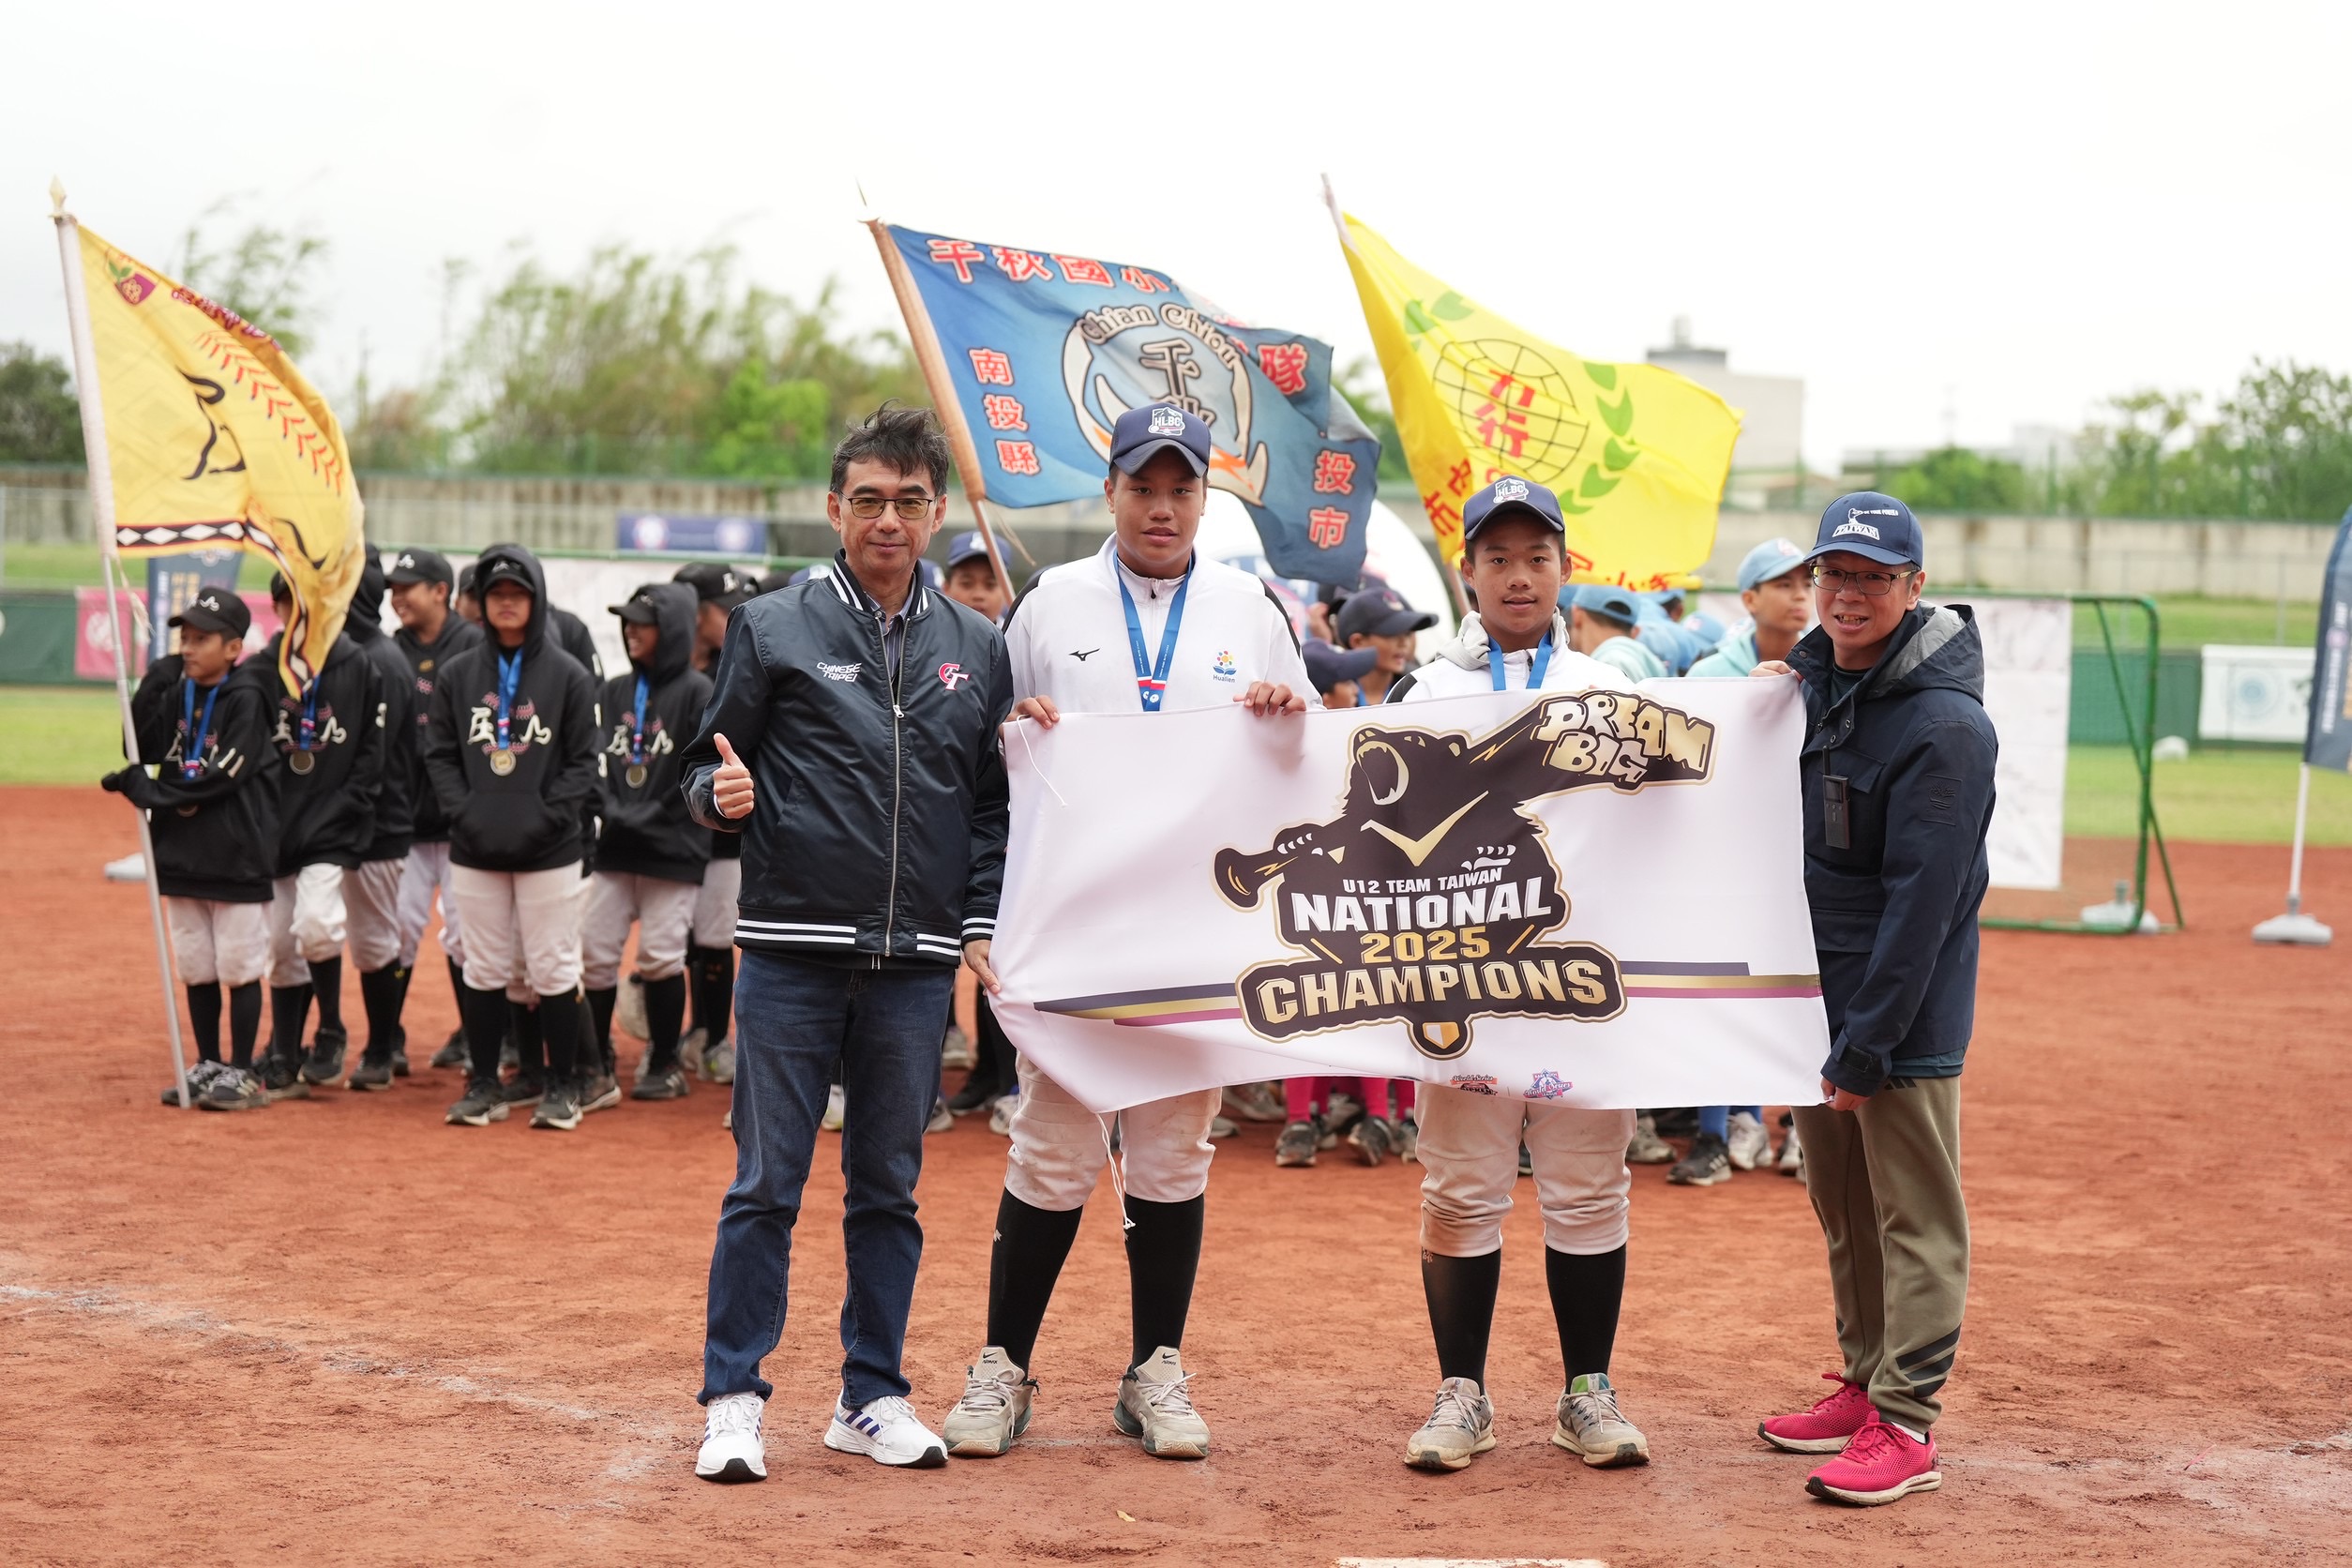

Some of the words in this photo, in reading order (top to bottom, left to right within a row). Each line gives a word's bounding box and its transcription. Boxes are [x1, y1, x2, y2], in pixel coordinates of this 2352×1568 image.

[969, 348, 1041, 475] 南投縣
[1154, 416, 1182, 427] HLBC
[1498, 484, 1525, 497] HLBC
[816, 661, 862, 673] CHINESE
[822, 670, 858, 683] TAIPEI
[1213, 674, 1236, 684] Hualien
[1535, 692, 1713, 774] DREAM
[1547, 731, 1650, 784] BIG
[1343, 879, 1380, 894] U12
[1386, 879, 1431, 893] TEAM
[1438, 867, 1503, 891] TAIWAN
[1290, 876, 1552, 932] NATIONAL
[1360, 926, 1491, 964] 2025
[1258, 958, 1609, 1025] CHAMPIONS
